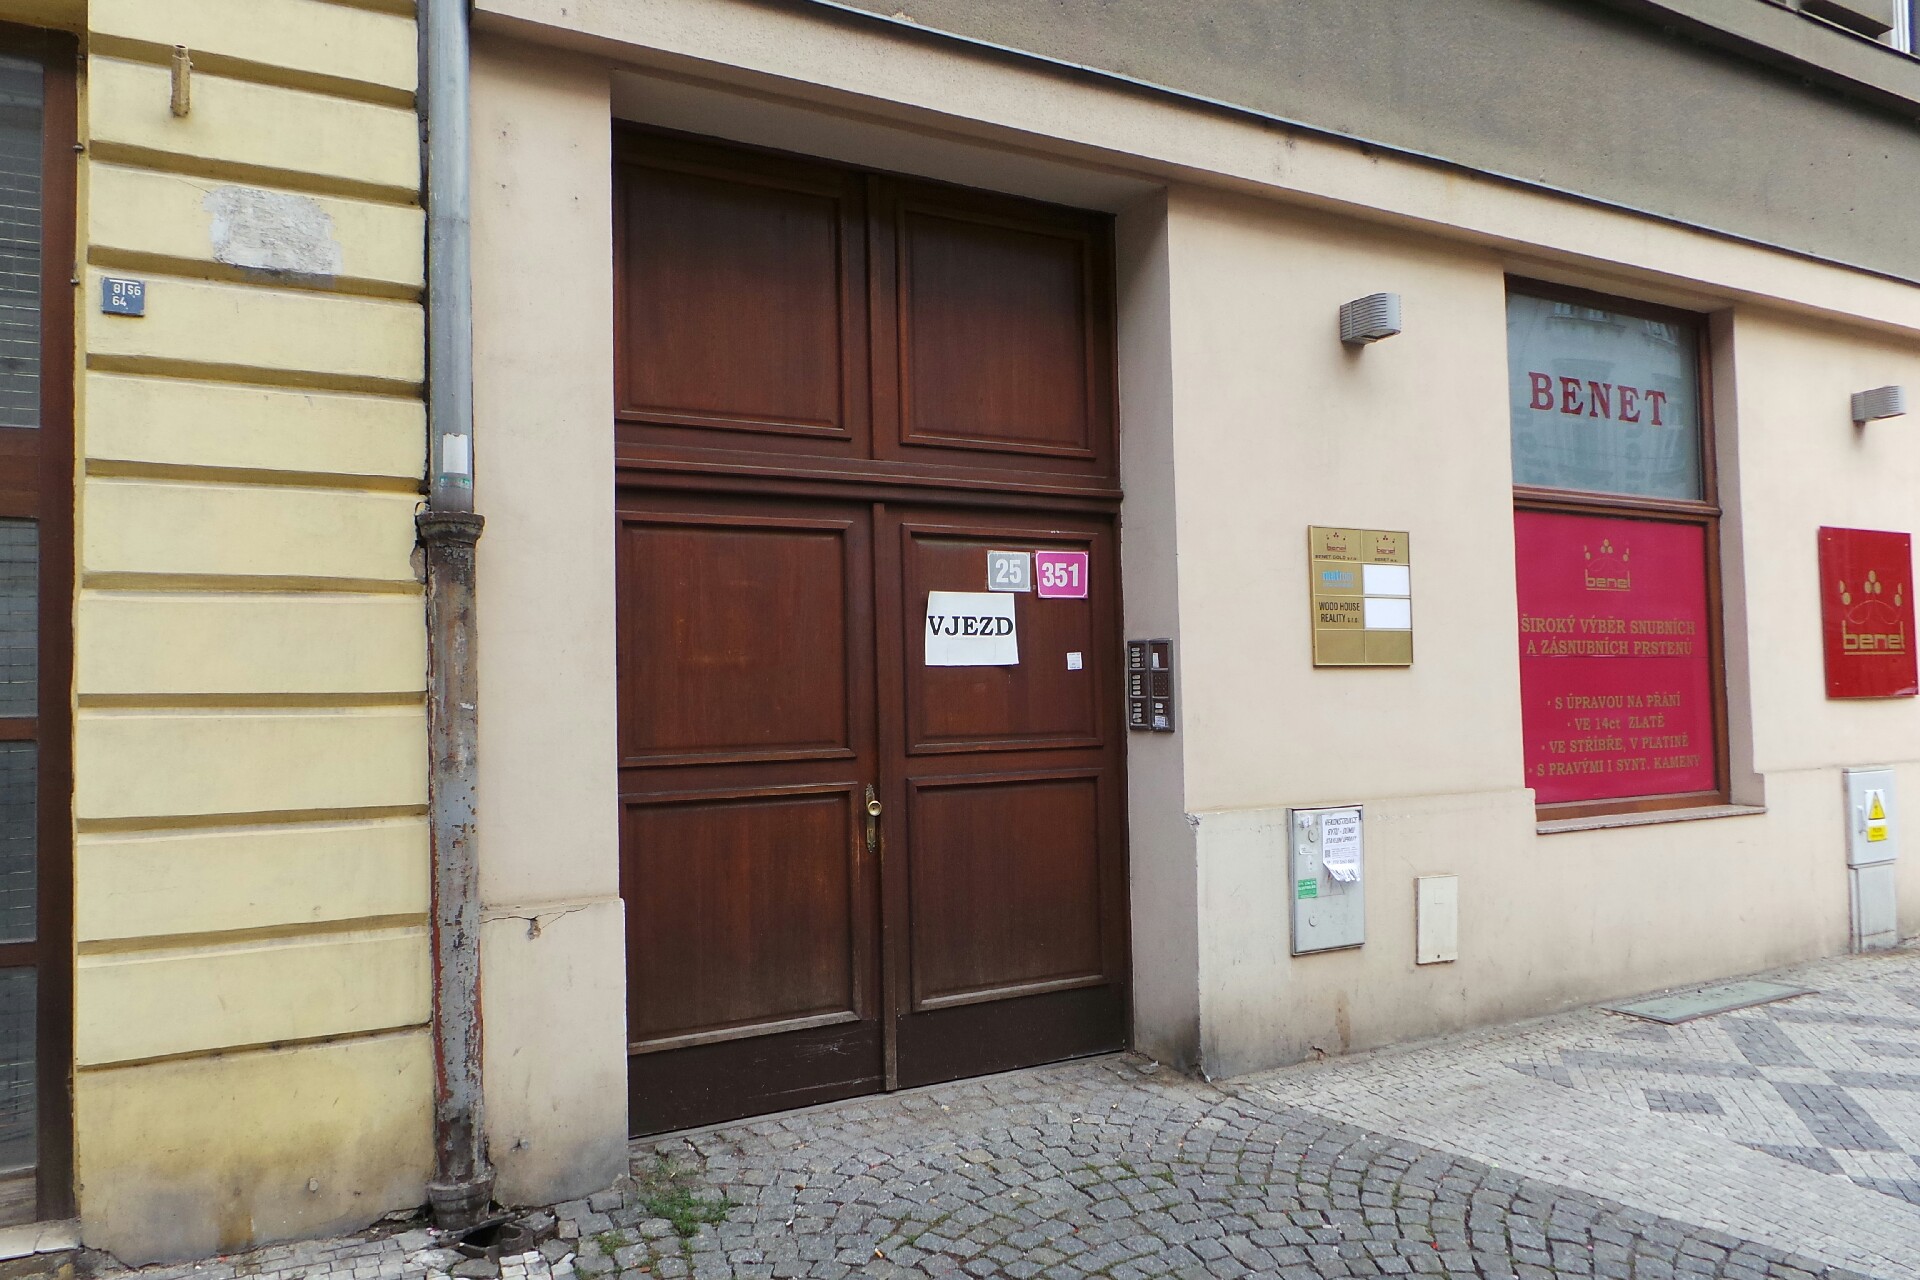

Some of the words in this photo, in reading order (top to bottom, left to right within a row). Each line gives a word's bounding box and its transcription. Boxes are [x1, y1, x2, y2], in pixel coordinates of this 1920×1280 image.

[112, 295, 127, 307] 64
[1528, 371, 1667, 426] BENET
[995, 558, 1022, 584] 25
[1041, 562, 1079, 588] 351
[1319, 601, 1338, 611] WOOD
[1339, 602, 1361, 612] HOUSE
[927, 615, 1014, 637] VJEZD
[1320, 613, 1346, 623] REALITY
[1520, 613, 1576, 633] ŠIROKÝ
[1580, 615, 1626, 635] VÝBĚR
[1630, 617, 1696, 636] SNUBNÍCH
[1526, 639, 1537, 655] A
[1541, 636, 1629, 655] ZÁSNUBNÍCH
[1555, 697, 1563, 710] S
[1567, 693, 1624, 709] ÚPRAVOU
[1627, 695, 1644, 708] NA
[1646, 691, 1681, 708] PŘÁNÍ
[1575, 718, 1591, 731] VE
[1549, 740, 1566, 754] VE
[1630, 737, 1639, 751] V
[1537, 763, 1546, 777] S
[1549, 757, 1604, 776] PRAVÝMI
[1607, 759, 1613, 774] I
